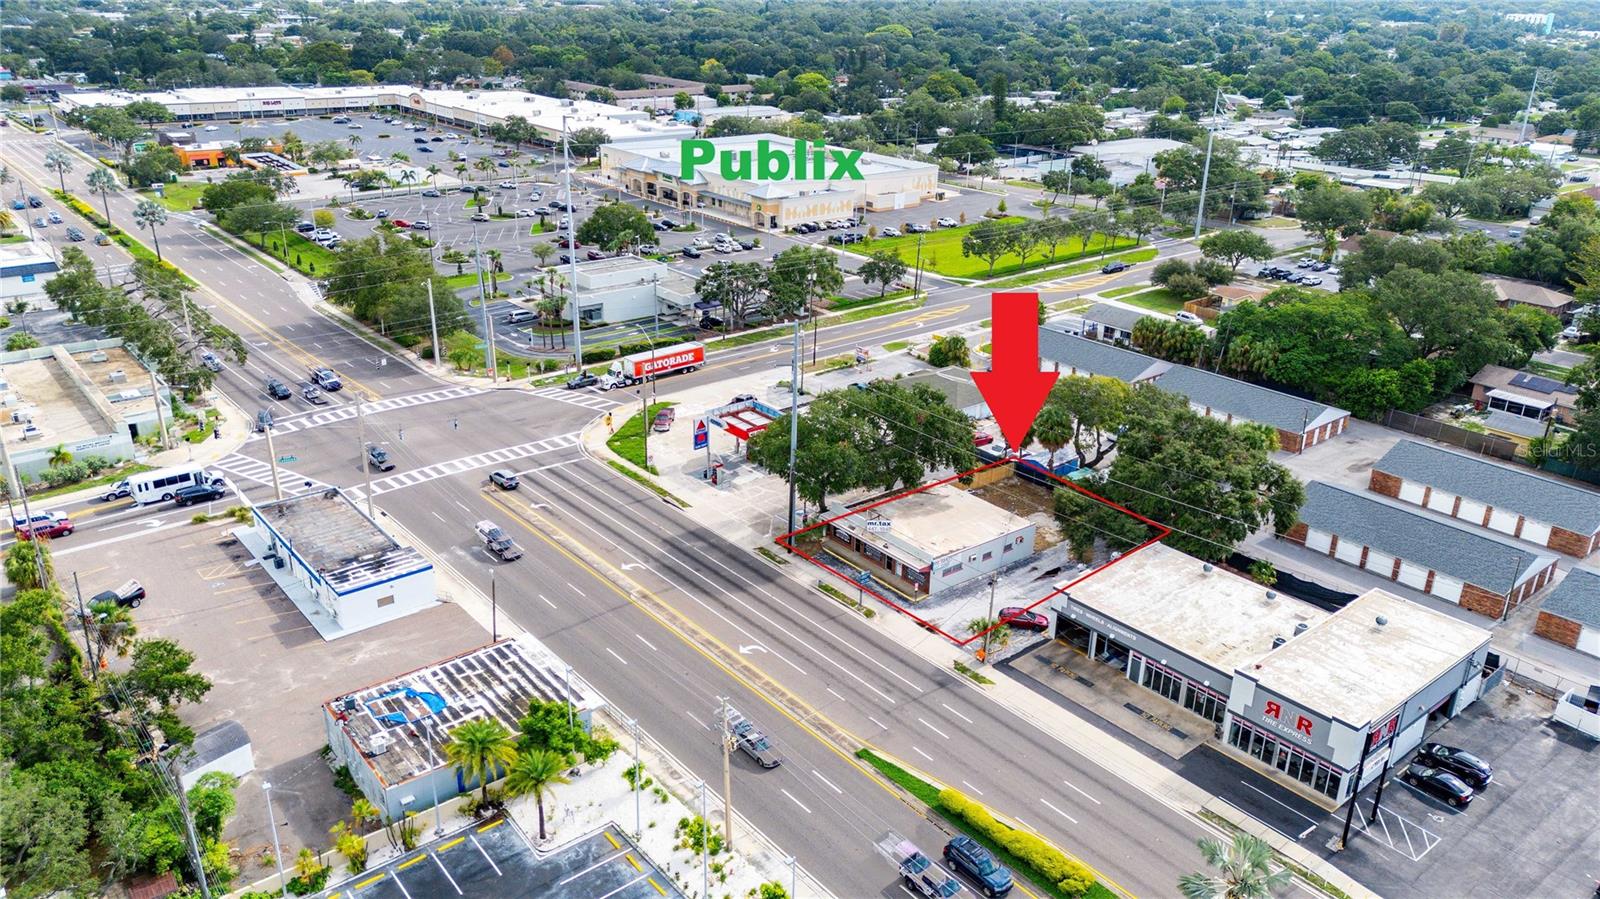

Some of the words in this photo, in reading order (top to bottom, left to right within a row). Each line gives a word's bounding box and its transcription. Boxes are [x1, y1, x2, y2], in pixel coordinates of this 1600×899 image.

[644, 353, 694, 370] GATORADE
[1262, 716, 1278, 727] TIRE
[1278, 724, 1313, 745] EXPRESS
